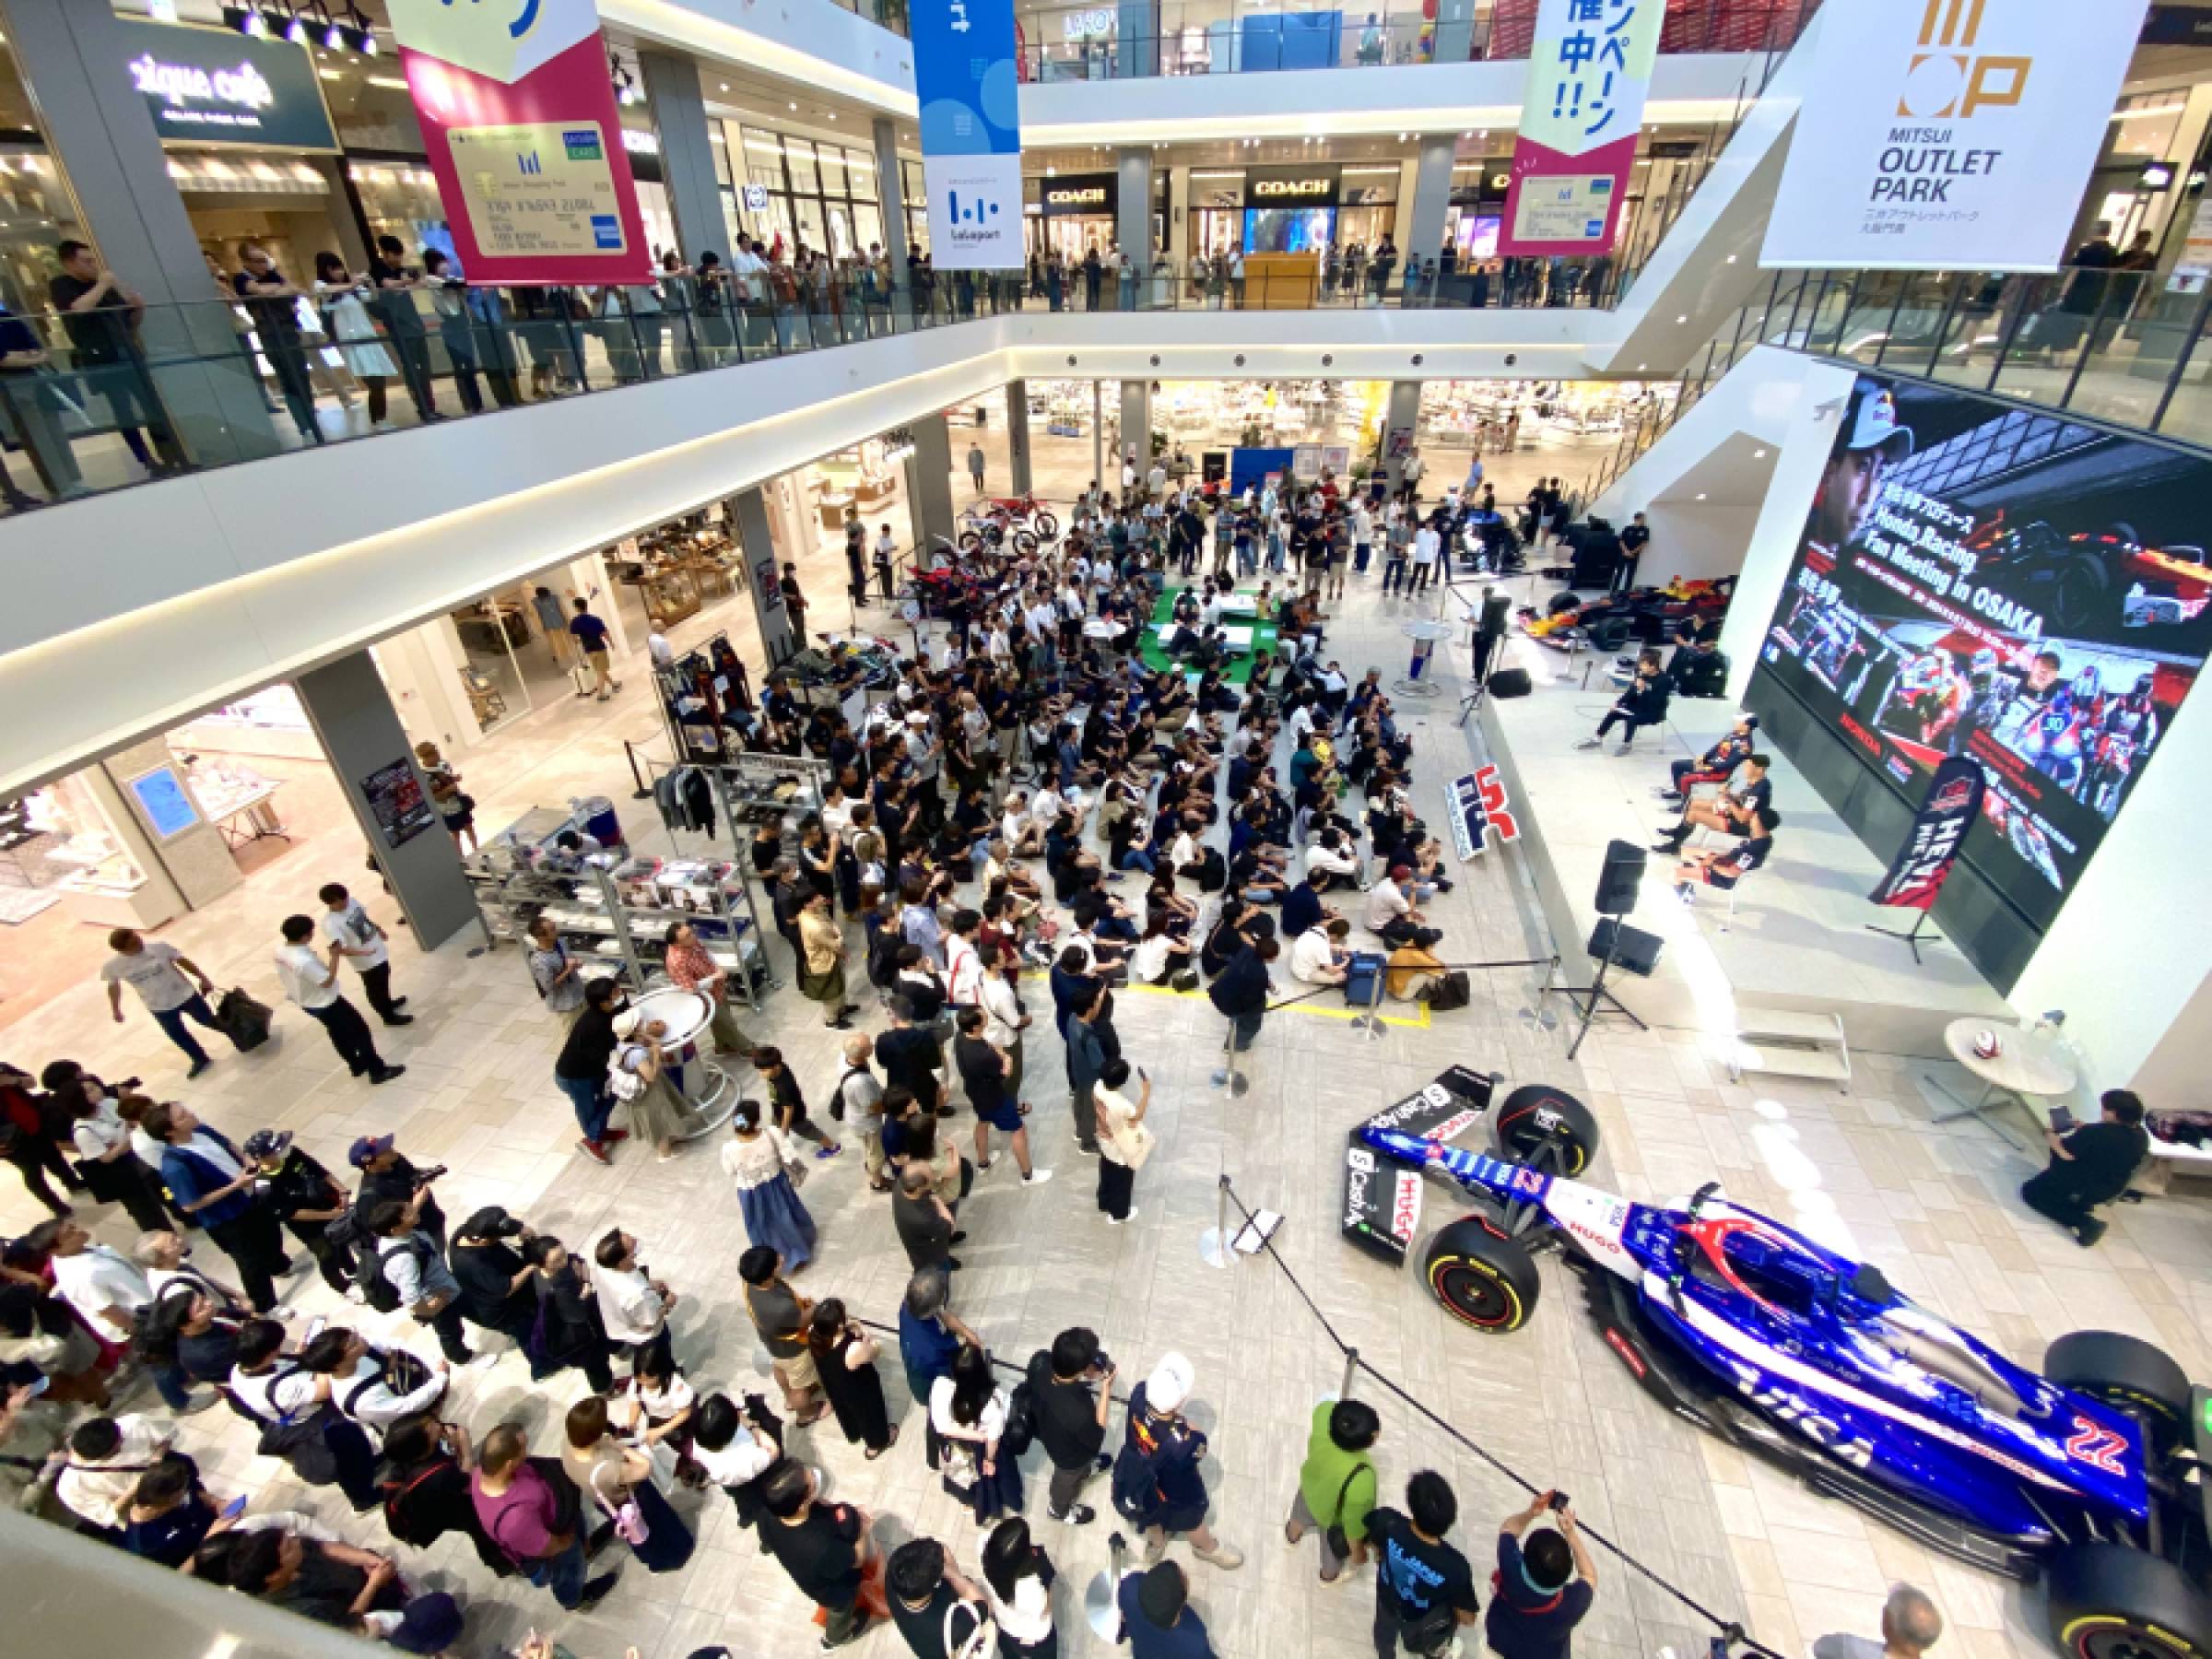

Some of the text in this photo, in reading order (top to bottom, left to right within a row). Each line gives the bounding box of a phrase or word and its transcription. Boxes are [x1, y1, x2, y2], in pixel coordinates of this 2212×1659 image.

[1888, 127, 1952, 143] MITSUI
[1879, 147, 2003, 174] OUTLET
[1047, 188, 1106, 203] COACH
[1254, 179, 1330, 196] COACH
[1870, 177, 1952, 202] PARK
[1972, 585, 2043, 642] OSAKA
[1394, 1178, 1417, 1243] HUGO
[1570, 1220, 1621, 1254] HUGO
[2065, 1414, 2130, 1478] 22
